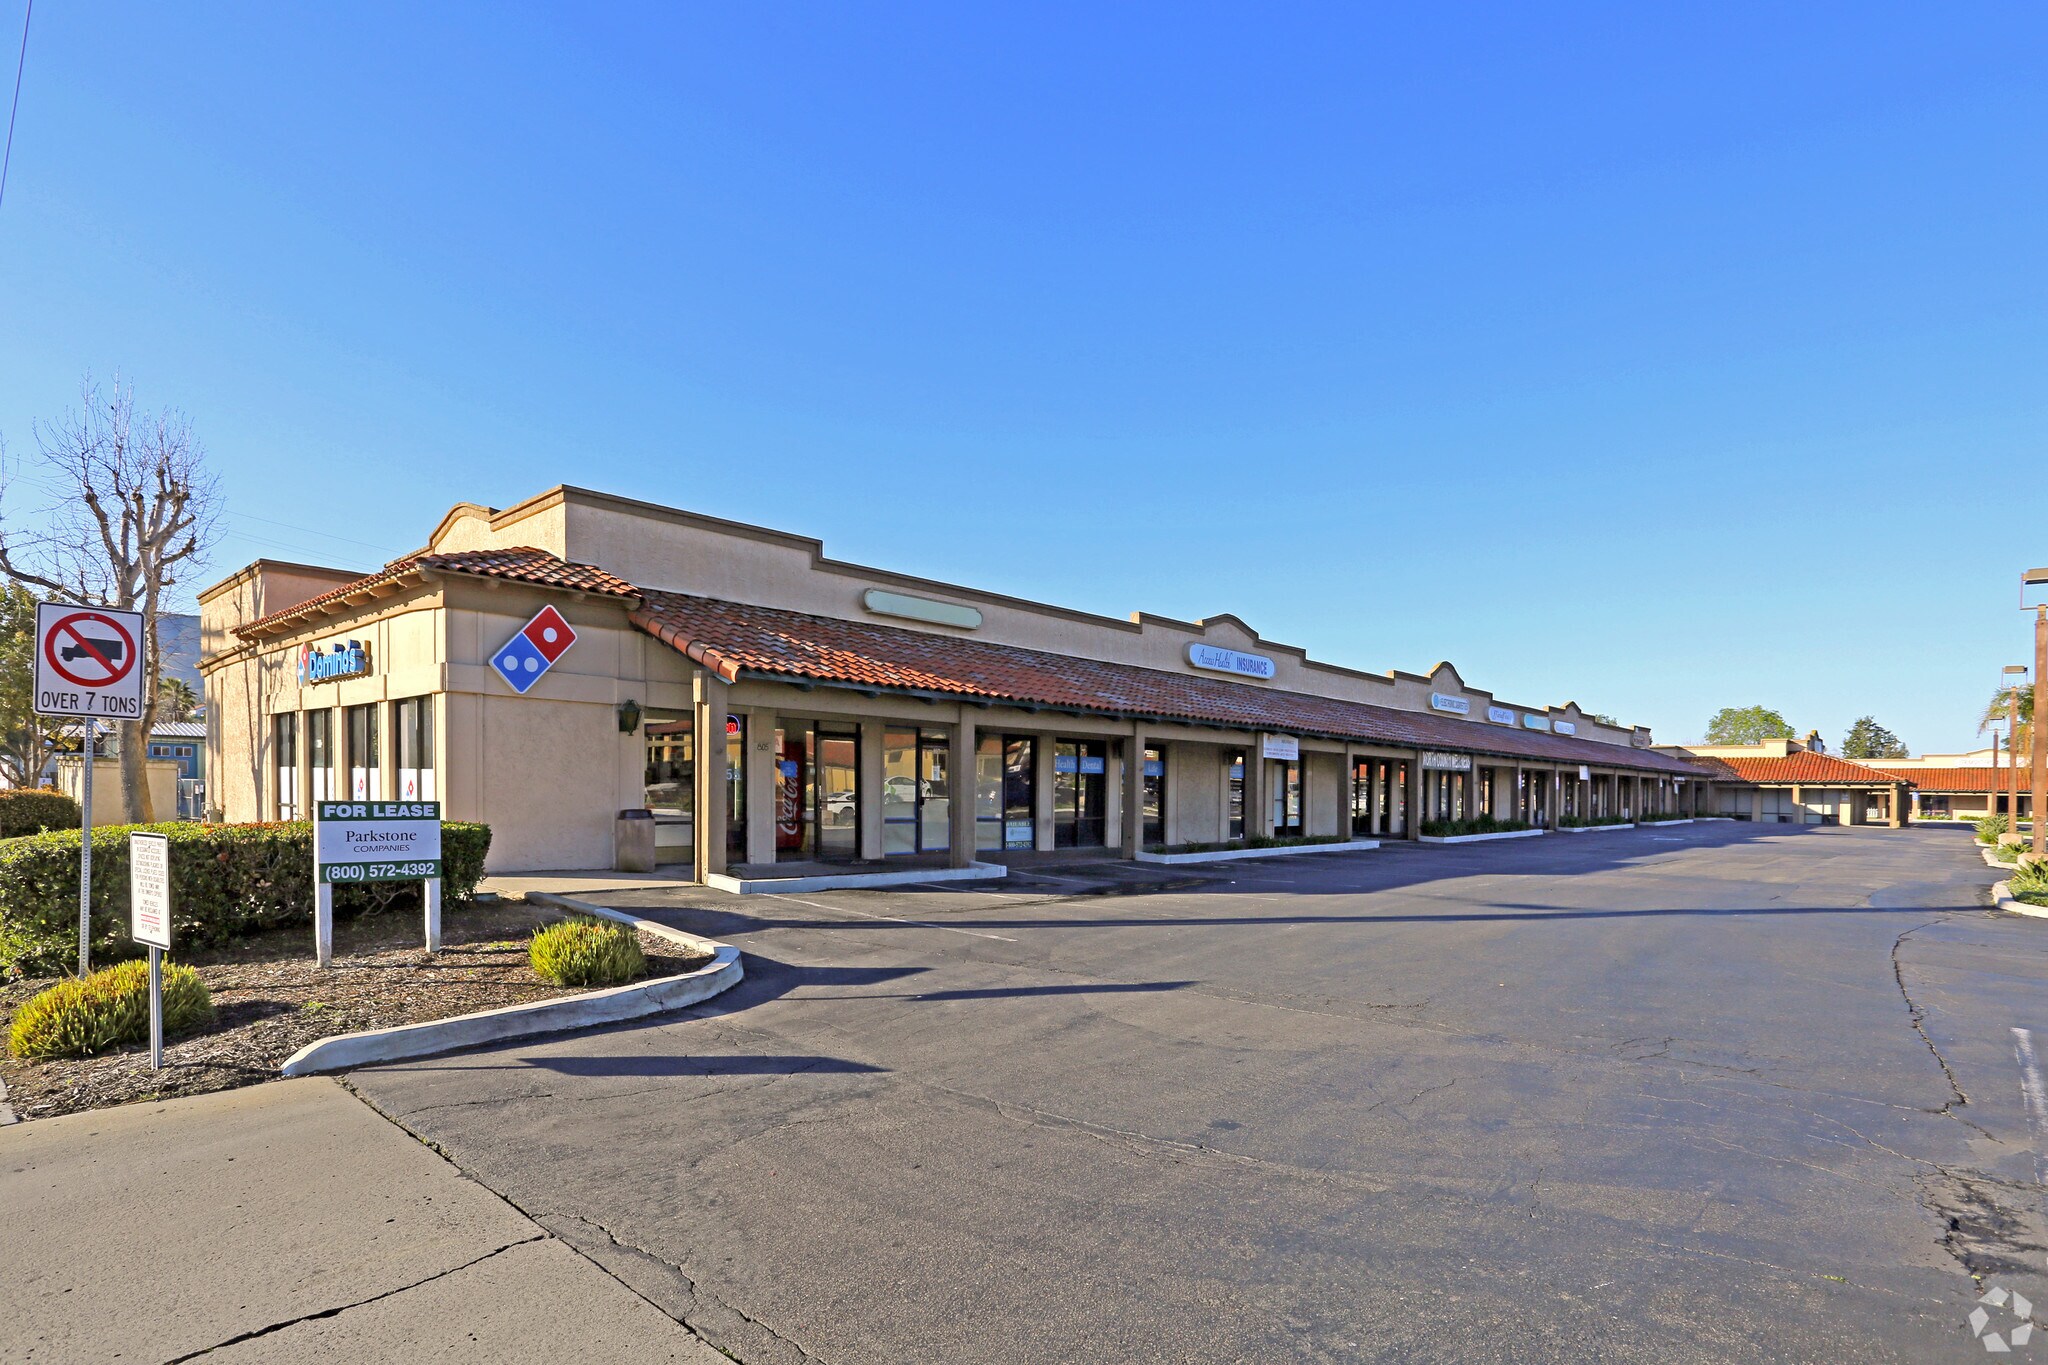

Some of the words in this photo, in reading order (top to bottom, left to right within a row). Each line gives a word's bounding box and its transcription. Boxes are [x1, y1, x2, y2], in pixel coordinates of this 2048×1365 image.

[1236, 656, 1268, 675] INSURANCE
[41, 691, 79, 711] OVER
[85, 691, 95, 711] 7
[101, 695, 137, 714] TONS
[1055, 759, 1075, 769] Health
[1082, 760, 1101, 770] Dental
[324, 804, 367, 818] FOR
[373, 803, 435, 818] LEASE
[345, 828, 417, 844] Parkstone
[353, 843, 410, 853] COMPANIES
[325, 863, 366, 883] (800)
[369, 862, 435, 879] 572-4392
